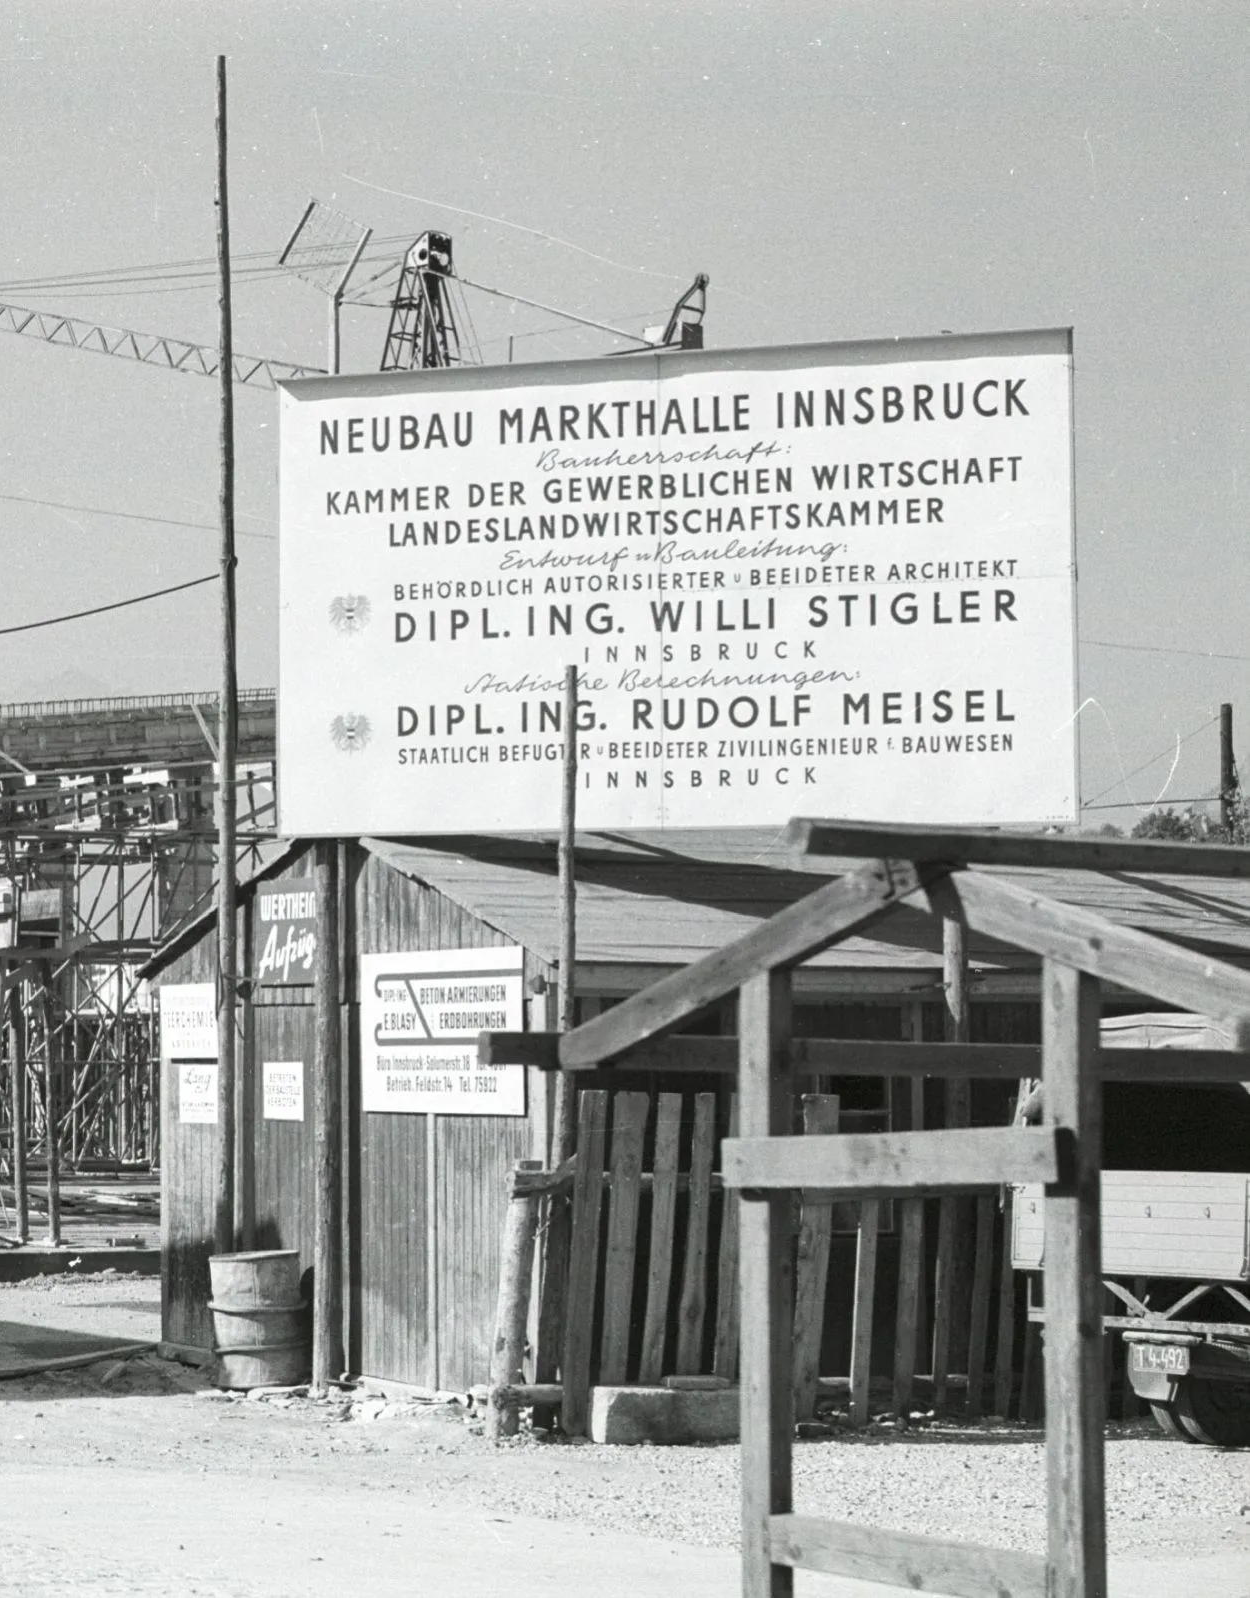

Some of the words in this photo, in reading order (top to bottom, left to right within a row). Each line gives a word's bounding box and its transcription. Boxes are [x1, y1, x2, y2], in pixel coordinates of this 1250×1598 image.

[320, 411, 473, 456] NEUBAU
[499, 395, 750, 445] MARKTHALLE
[776, 378, 1030, 429] INNSBRUCK
[536, 442, 792, 473] Bauherrschaft:
[326, 485, 450, 516] KAMMER
[468, 480, 527, 508] DER
[543, 467, 793, 504] GEWERBLICHEN
[811, 455, 1023, 491] WIRTSCHAFT
[389, 497, 944, 548] LANDESLANDWIRTSCHAFTSKAMMER
[499, 547, 629, 573] Entwurf
[653, 538, 848, 566] Bauleitung:
[393, 578, 533, 602] BEHÖRDLICH
[543, 571, 726, 595] AUTORISIERTER
[750, 565, 876, 587] BEEIDETER
[886, 559, 1018, 581] ARCHITEKT
[394, 607, 511, 643] DIPL.
[528, 602, 625, 637] ING.
[649, 597, 775, 633] WILLI
[808, 589, 1018, 628] STIGLER
[584, 640, 816, 663] INNSBRUCK
[617, 668, 861, 692] Berechnungen:
[397, 703, 505, 737] DIPL.
[521, 700, 607, 734] ING.
[632, 693, 811, 731] RUDOLF
[842, 688, 1016, 726] MEISEL
[398, 745, 489, 765] STAATLICH
[499, 742, 591, 762] BEFUGTR
[608, 739, 708, 759] BEEIDETER
[717, 737, 878, 758] ZIVILINGENIEUR
[902, 733, 1013, 754] BAUWESEN
[585, 766, 816, 789] INNSBRUCK
[258, 924, 317, 981] Aufzüg
[439, 1011, 507, 1029] ERDBOHRUNGEN
